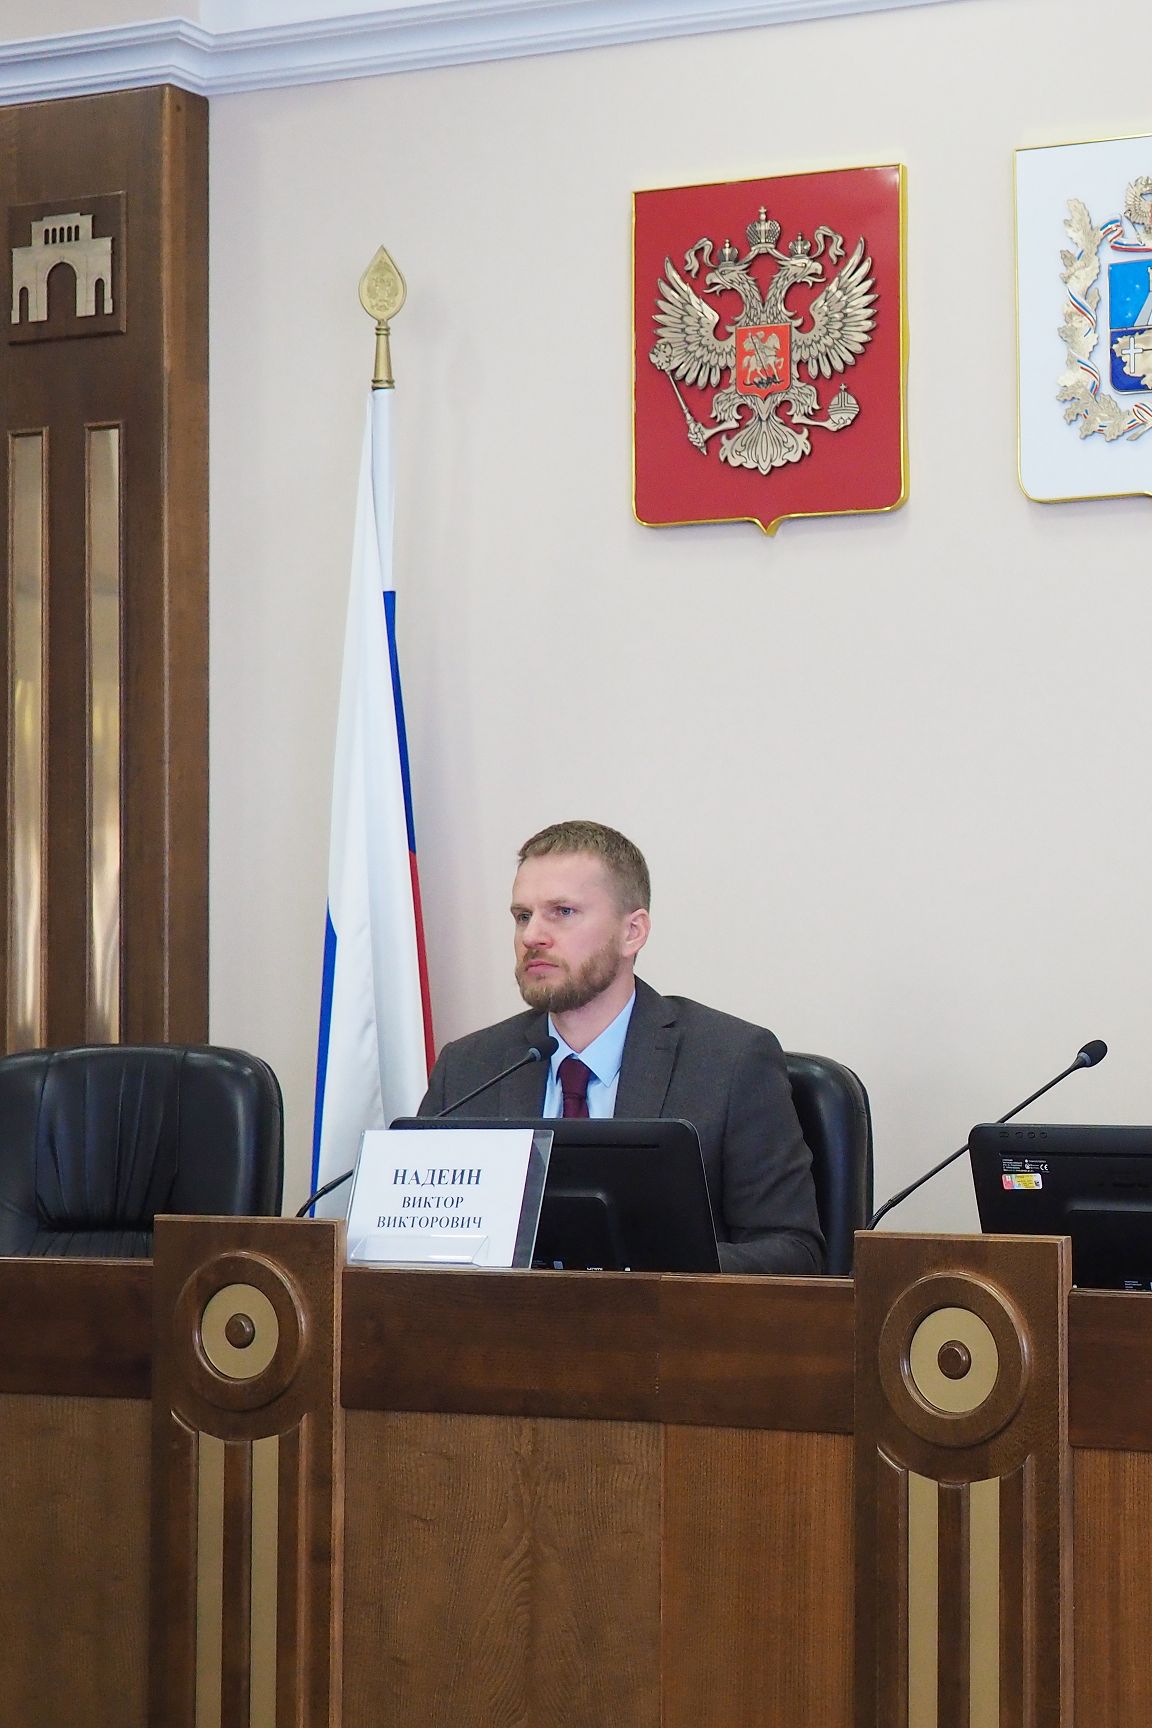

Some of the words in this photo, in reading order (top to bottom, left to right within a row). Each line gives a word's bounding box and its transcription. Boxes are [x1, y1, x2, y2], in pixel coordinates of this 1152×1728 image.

[392, 1168, 482, 1187] НАДЕИН
[402, 1196, 464, 1209] ВИКТОР
[376, 1215, 482, 1229] ВИКТОРОВИЧ
